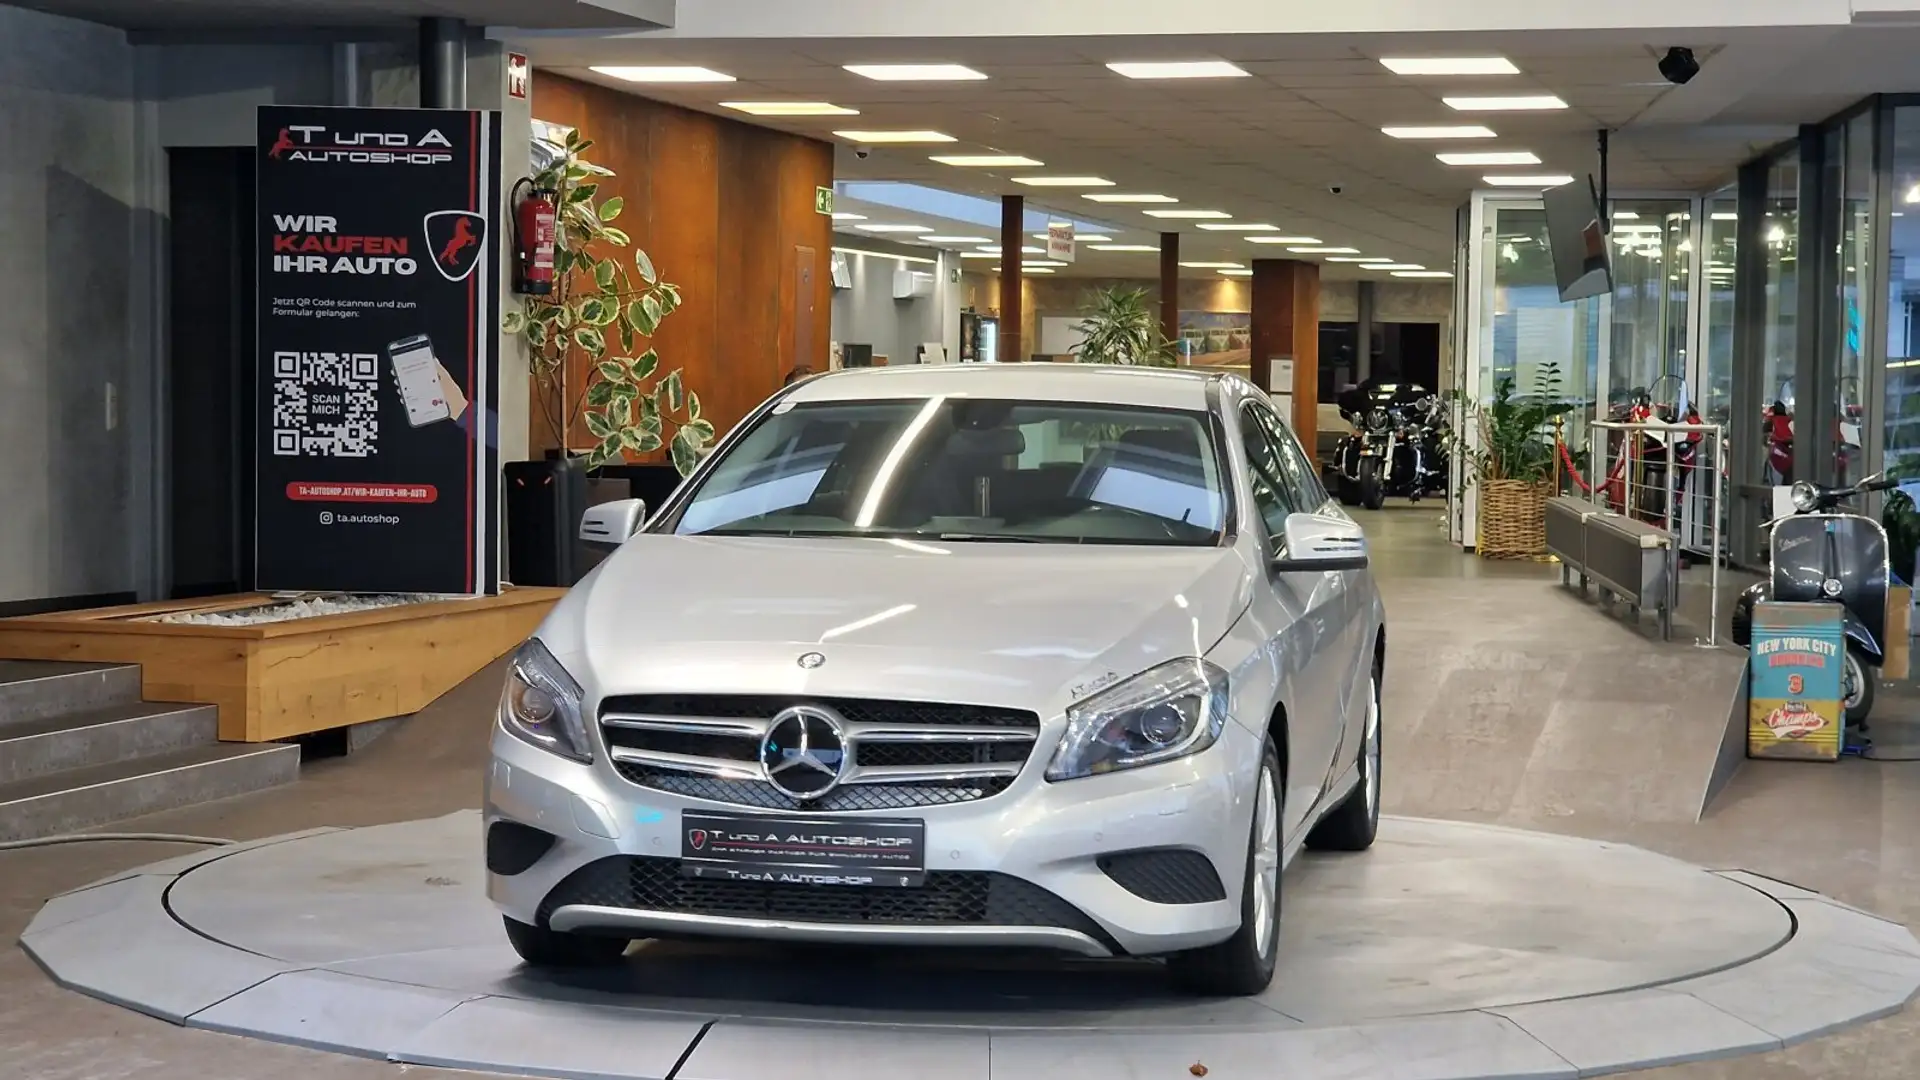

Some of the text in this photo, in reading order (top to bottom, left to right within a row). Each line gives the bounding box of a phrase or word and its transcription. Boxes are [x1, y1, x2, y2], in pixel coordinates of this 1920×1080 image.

[289, 125, 326, 143] T
[416, 129, 452, 147] A
[288, 150, 452, 165] AUTOSHOP
[273, 214, 337, 233] WIR
[273, 234, 408, 254] KAUFEN
[273, 255, 418, 275] IHR AUTO
[272, 297, 294, 306] Jetzt
[296, 298, 310, 307] QR
[312, 298, 335, 307] Code
[337, 300, 374, 308] scannen
[376, 300, 395, 309] und
[272, 307, 360, 318] Formular gelangen:
[312, 394, 341, 405] SCAN
[312, 405, 341, 415] MICH
[337, 514, 400, 524] ta.autoshop
[1757, 636, 1836, 656] NEW YORK CITY
[709, 831, 724, 840] T
[765, 834, 780, 842] A
[786, 834, 912, 846] AUTOSHOP
[727, 870, 739, 878] T
[763, 873, 774, 881] A
[779, 873, 873, 884] AUTOSHOP
